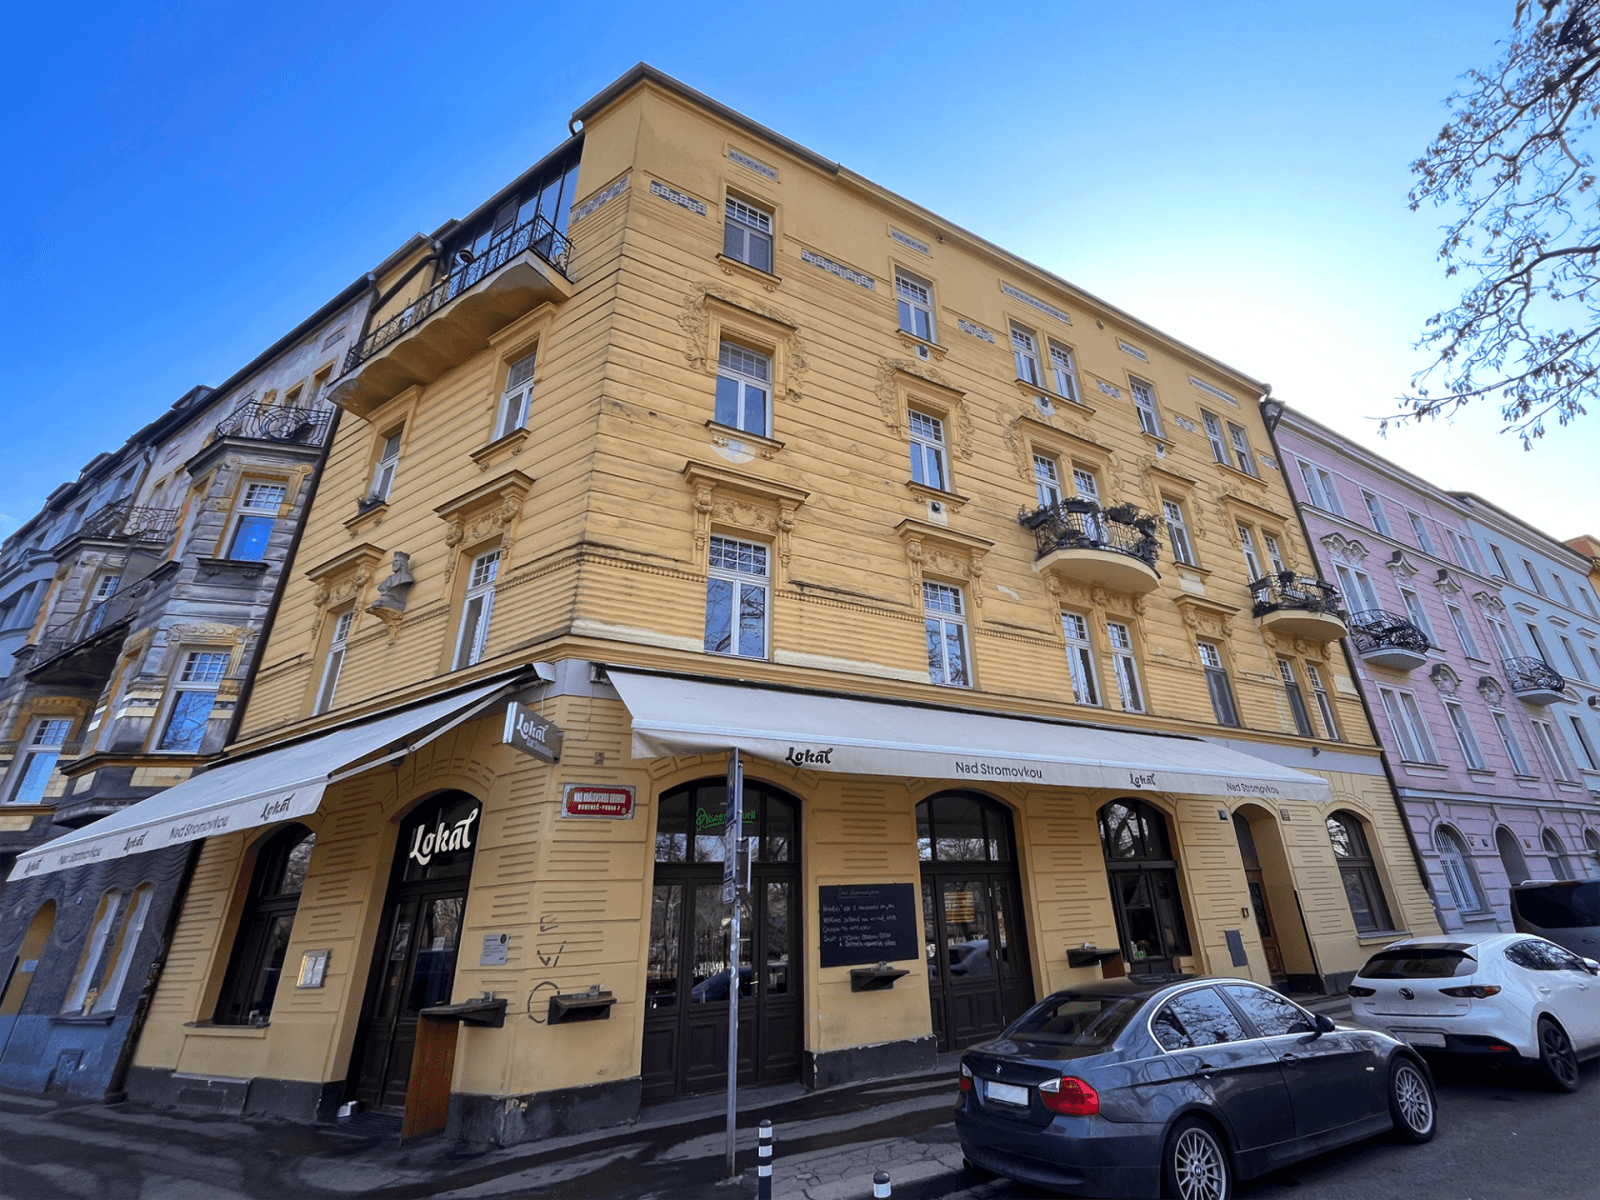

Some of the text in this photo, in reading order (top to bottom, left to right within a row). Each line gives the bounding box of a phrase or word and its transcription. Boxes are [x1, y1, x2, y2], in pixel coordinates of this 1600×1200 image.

[955, 761, 1043, 779] Nad Stromovkou
[1226, 782, 1240, 792] Nad
